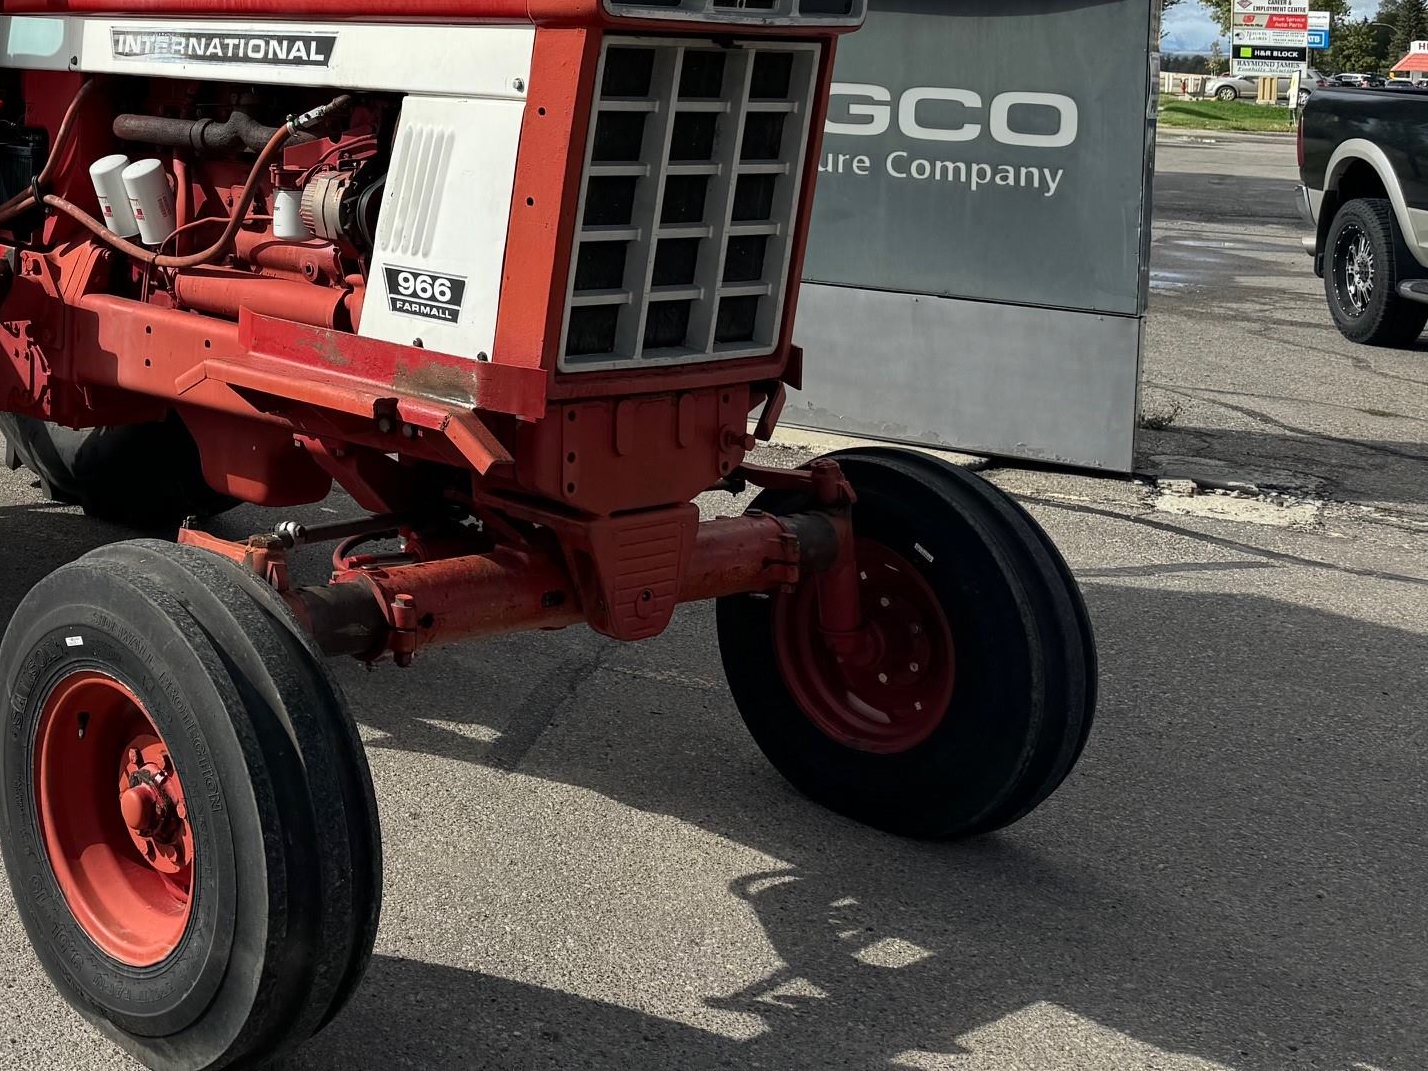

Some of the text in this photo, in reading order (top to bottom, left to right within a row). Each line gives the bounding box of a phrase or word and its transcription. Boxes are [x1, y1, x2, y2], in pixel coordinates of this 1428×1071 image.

[115, 34, 325, 61] INTERNATIONAL
[1272, 50, 1299, 58] BLOCK
[1236, 60, 1300, 69] RAYMOND JAMES
[886, 151, 1064, 197] Company
[397, 272, 452, 300] 966
[396, 301, 452, 319] FARMALL
